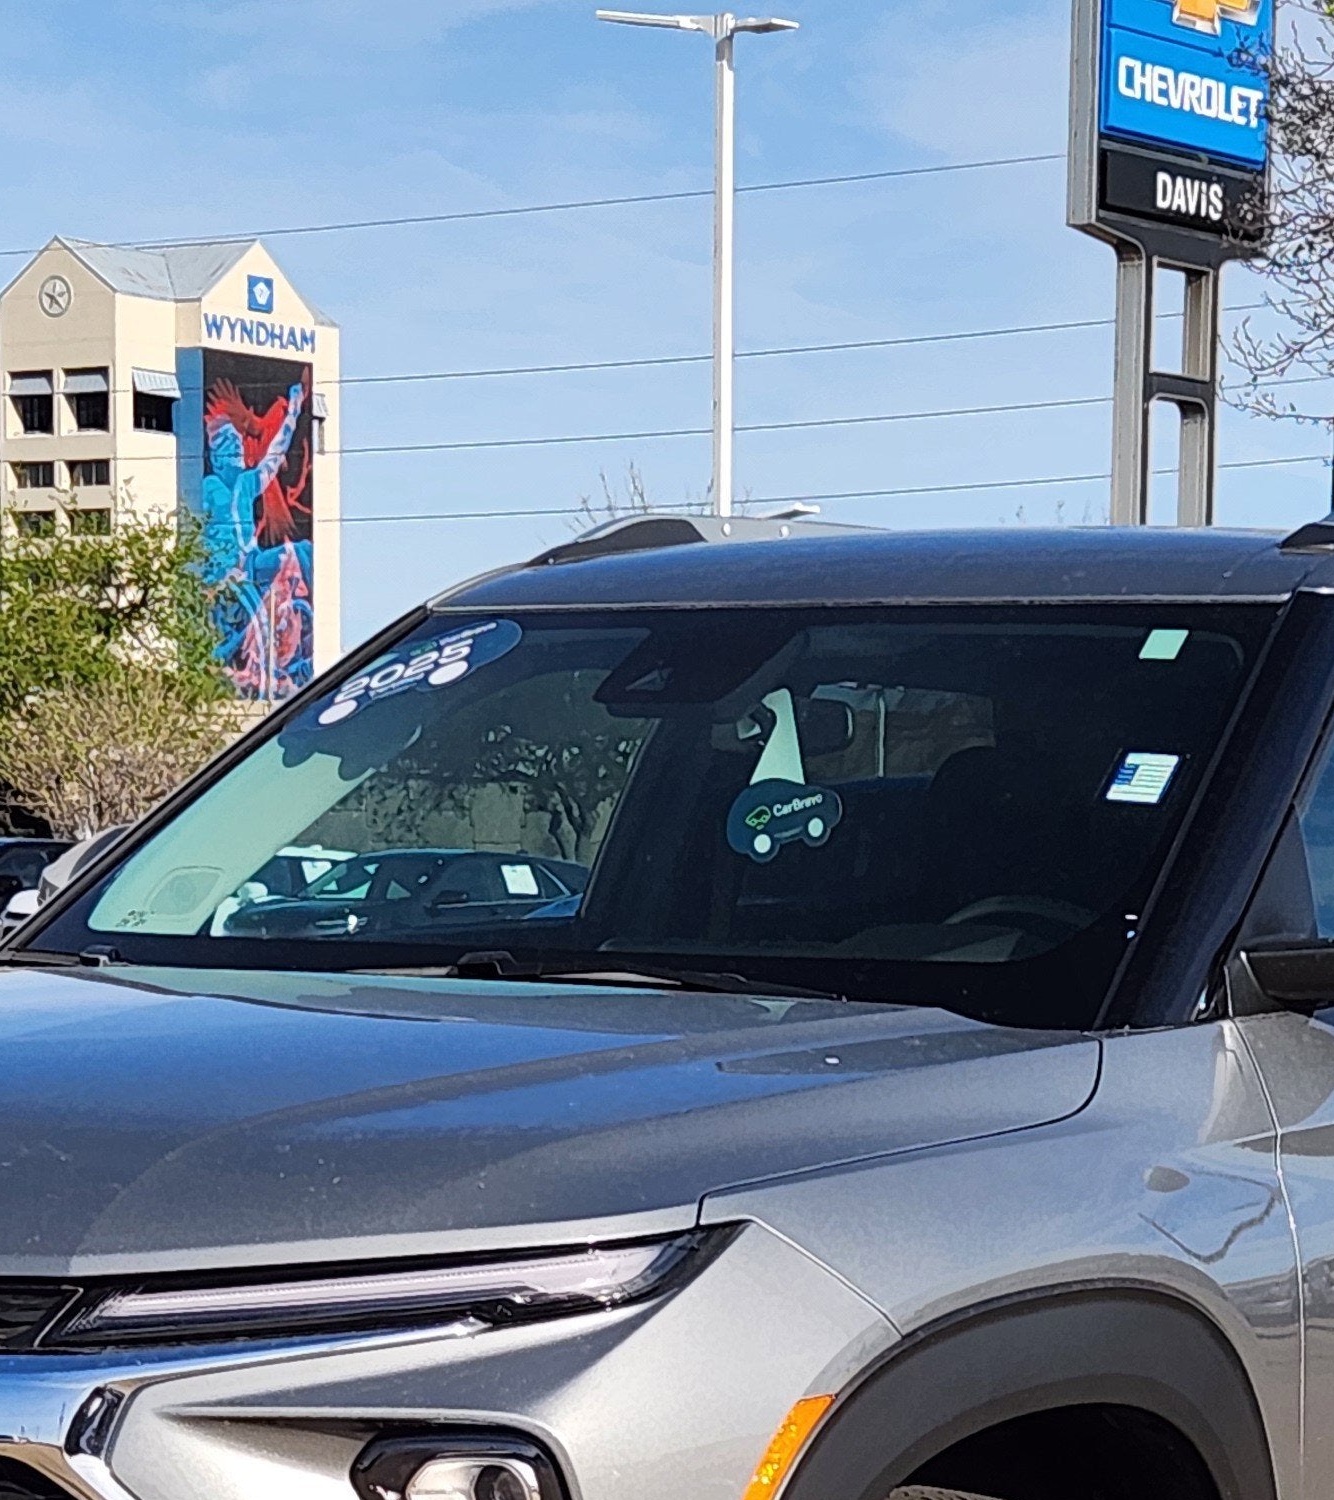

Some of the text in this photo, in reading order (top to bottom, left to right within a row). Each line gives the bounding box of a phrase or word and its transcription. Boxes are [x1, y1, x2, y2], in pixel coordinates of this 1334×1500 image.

[1119, 56, 1264, 127] CHEVROLET
[1156, 171, 1223, 221] DAVIS
[203, 312, 315, 354] WYNDHAM
[335, 638, 474, 704] 2025
